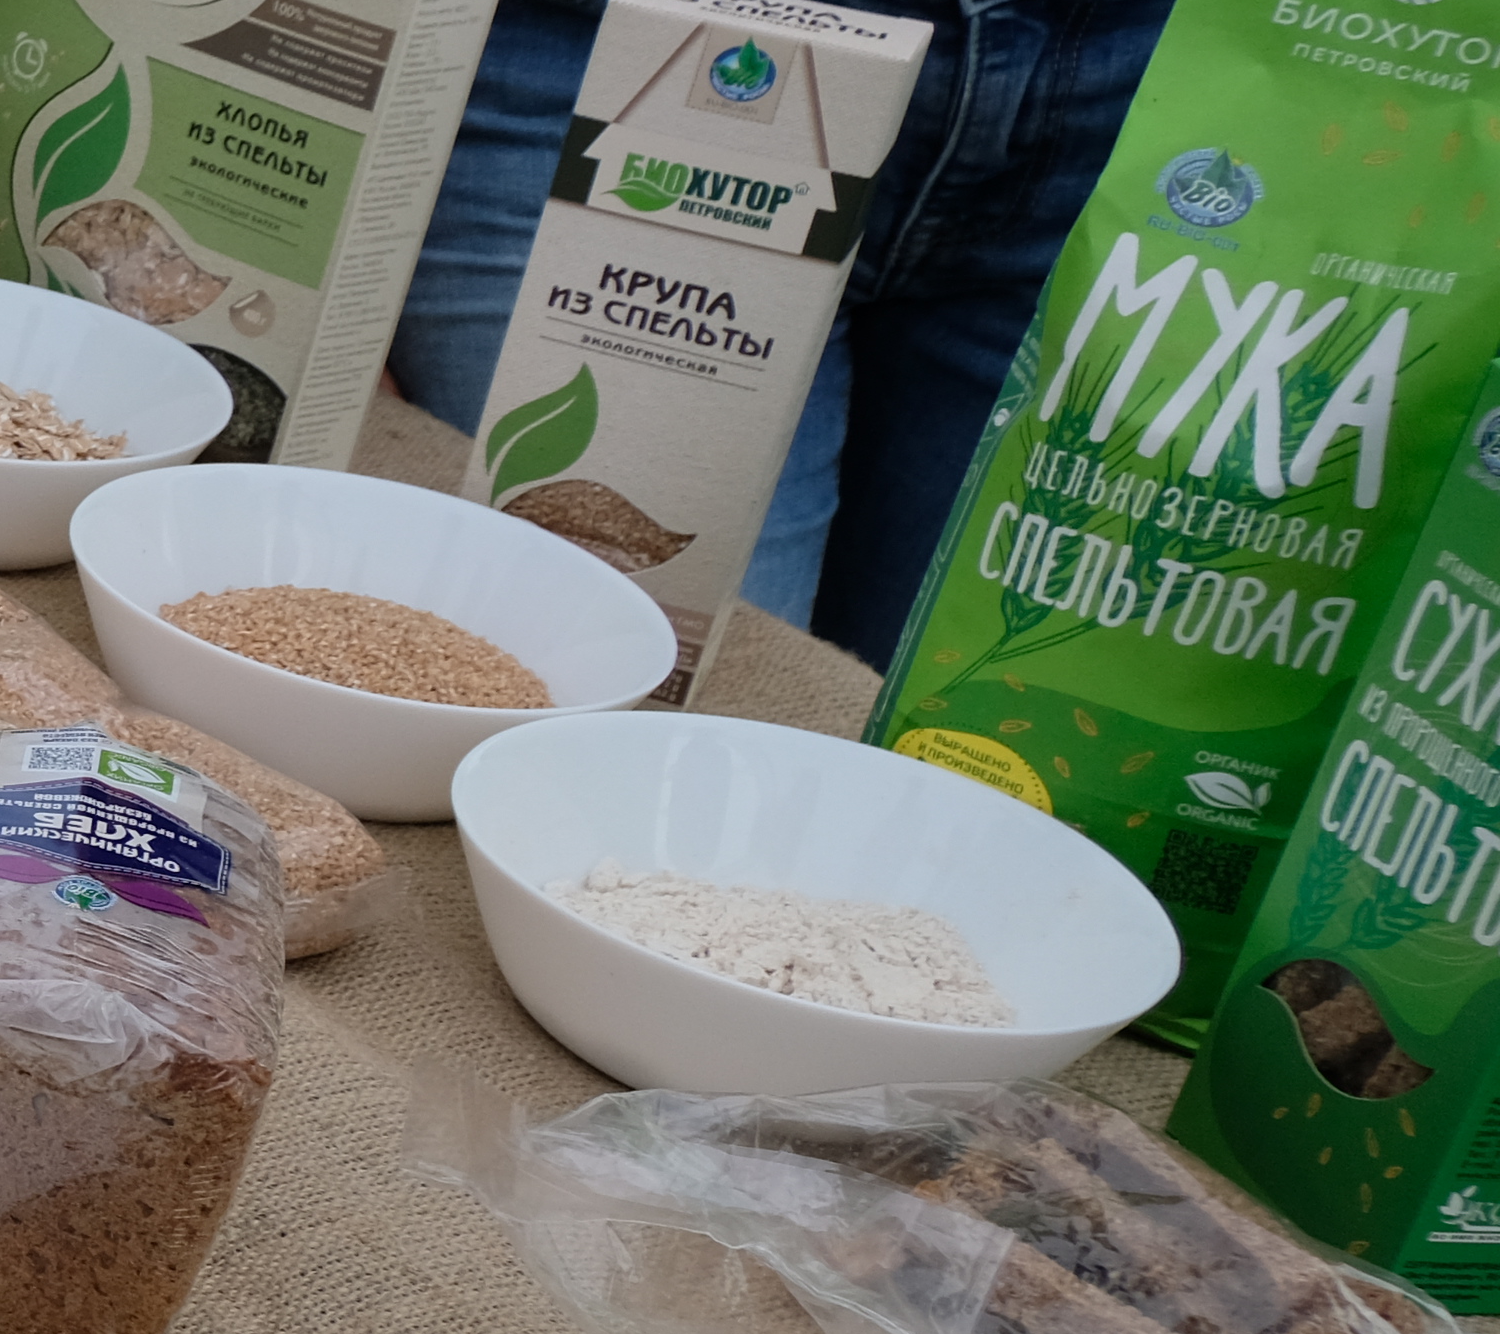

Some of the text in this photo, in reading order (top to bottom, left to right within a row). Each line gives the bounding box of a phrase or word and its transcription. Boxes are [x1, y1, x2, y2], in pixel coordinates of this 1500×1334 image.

[712, 0, 889, 41] СПЕЛЬТЫ
[1291, 42, 1473, 92] ПЕТРОВСКИЙ
[216, 100, 310, 149] ХЛОПЬЯ
[187, 121, 329, 188] ИЗ СПЕЛЬТЫ
[189, 155, 309, 209] экологические
[618, 151, 793, 213] БИОХУТОР
[1181, 180, 1236, 216] Bio
[678, 197, 774, 232] ПЕТРОВСКИЙ
[598, 262, 737, 321] КРУПА
[1309, 251, 1459, 295] ОРГАНИЧЕСКАЯ
[548, 285, 775, 360] ИЗ СПЕЛЬТЫ
[580, 331, 718, 377] экологическая
[1038, 231, 1410, 510] МУКА
[1022, 441, 1366, 571] ЦЕЛЬНОЗЕРНОВАЯ
[977, 501, 1358, 677] СПЕЛЬТОВАЯ
[1357, 682, 1389, 723] ИЗ
[917, 741, 1024, 796] И ПРОИЗВЕДЕНО
[933, 731, 1012, 773] ВЫРАЩЕНО
[1193, 750, 1282, 781] ОРГАНИК
[34, 793, 152, 822] БЕЗДРОЖЖЕВОЙ
[67, 803, 176, 840] ПРОРОЩЕННОЙ
[1175, 802, 1260, 832] ORGANIC
[0, 825, 181, 873] ОРГАНИЧЕСКИЙ
[34, 811, 157, 853] ХЛЕБ
[179, 836, 198, 848] ИЗ
